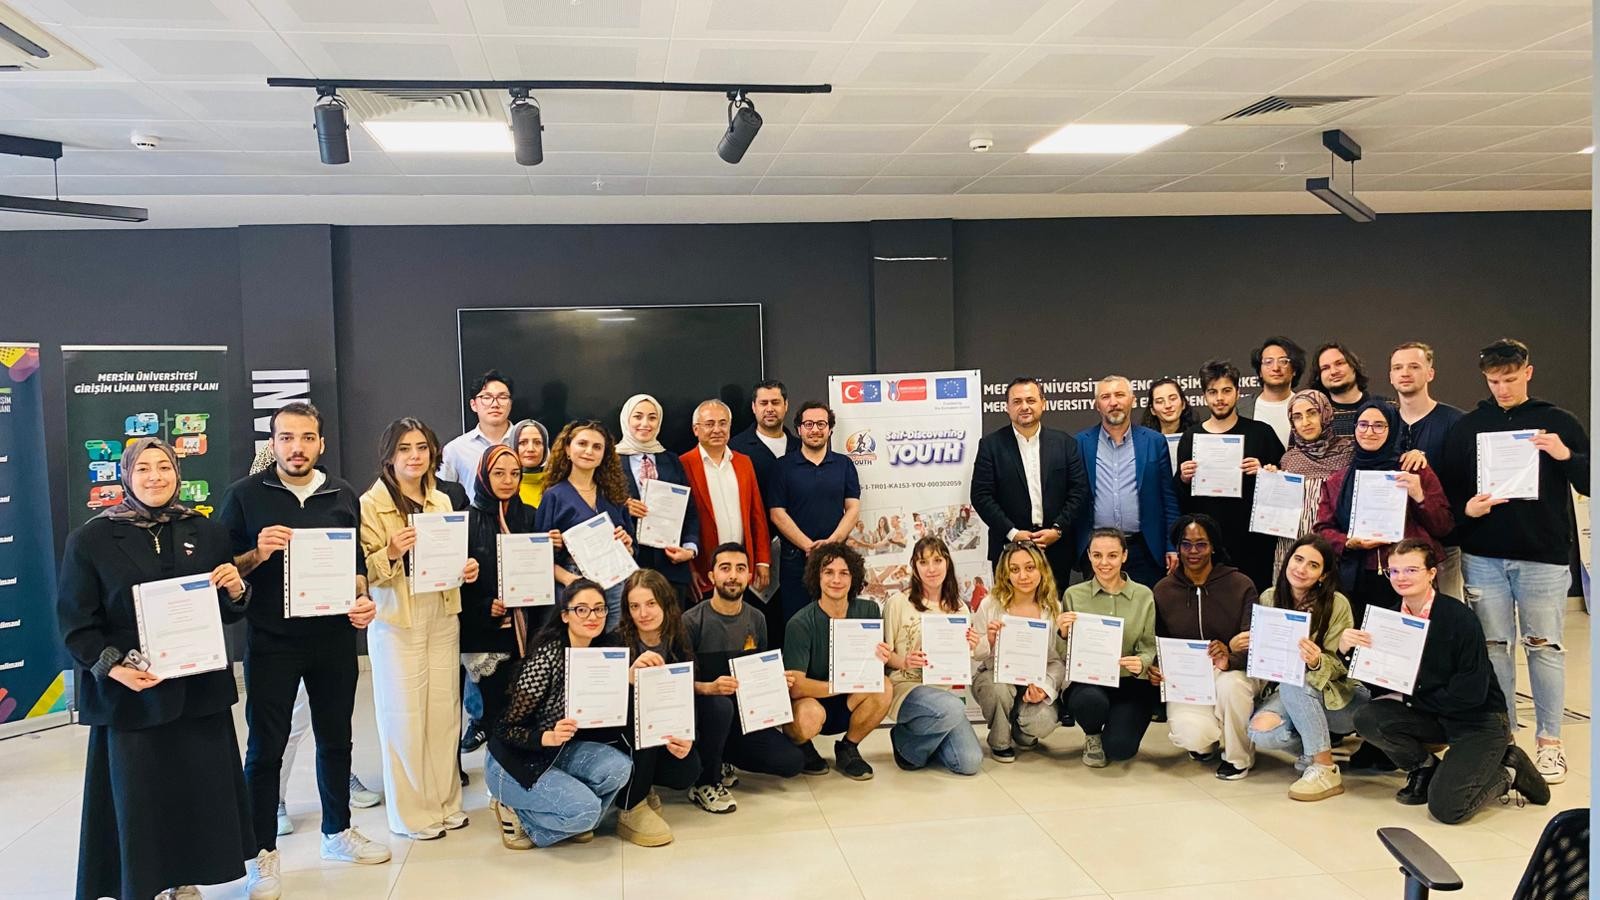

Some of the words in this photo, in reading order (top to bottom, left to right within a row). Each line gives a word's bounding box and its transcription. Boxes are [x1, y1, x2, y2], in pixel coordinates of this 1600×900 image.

[97, 372, 134, 382] MERSİN
[136, 370, 198, 381] ÜNİVERSİTESİ
[74, 383, 112, 395] GİRİŞİM
[113, 382, 146, 393] LİMANI
[148, 382, 192, 393] YERLEŞKE
[192, 382, 219, 391] PLANI
[983, 383, 1009, 395] MER
[983, 401, 1008, 413] MER
[886, 429, 966, 442] Self-Discovering
[887, 441, 963, 465] YOUTH
